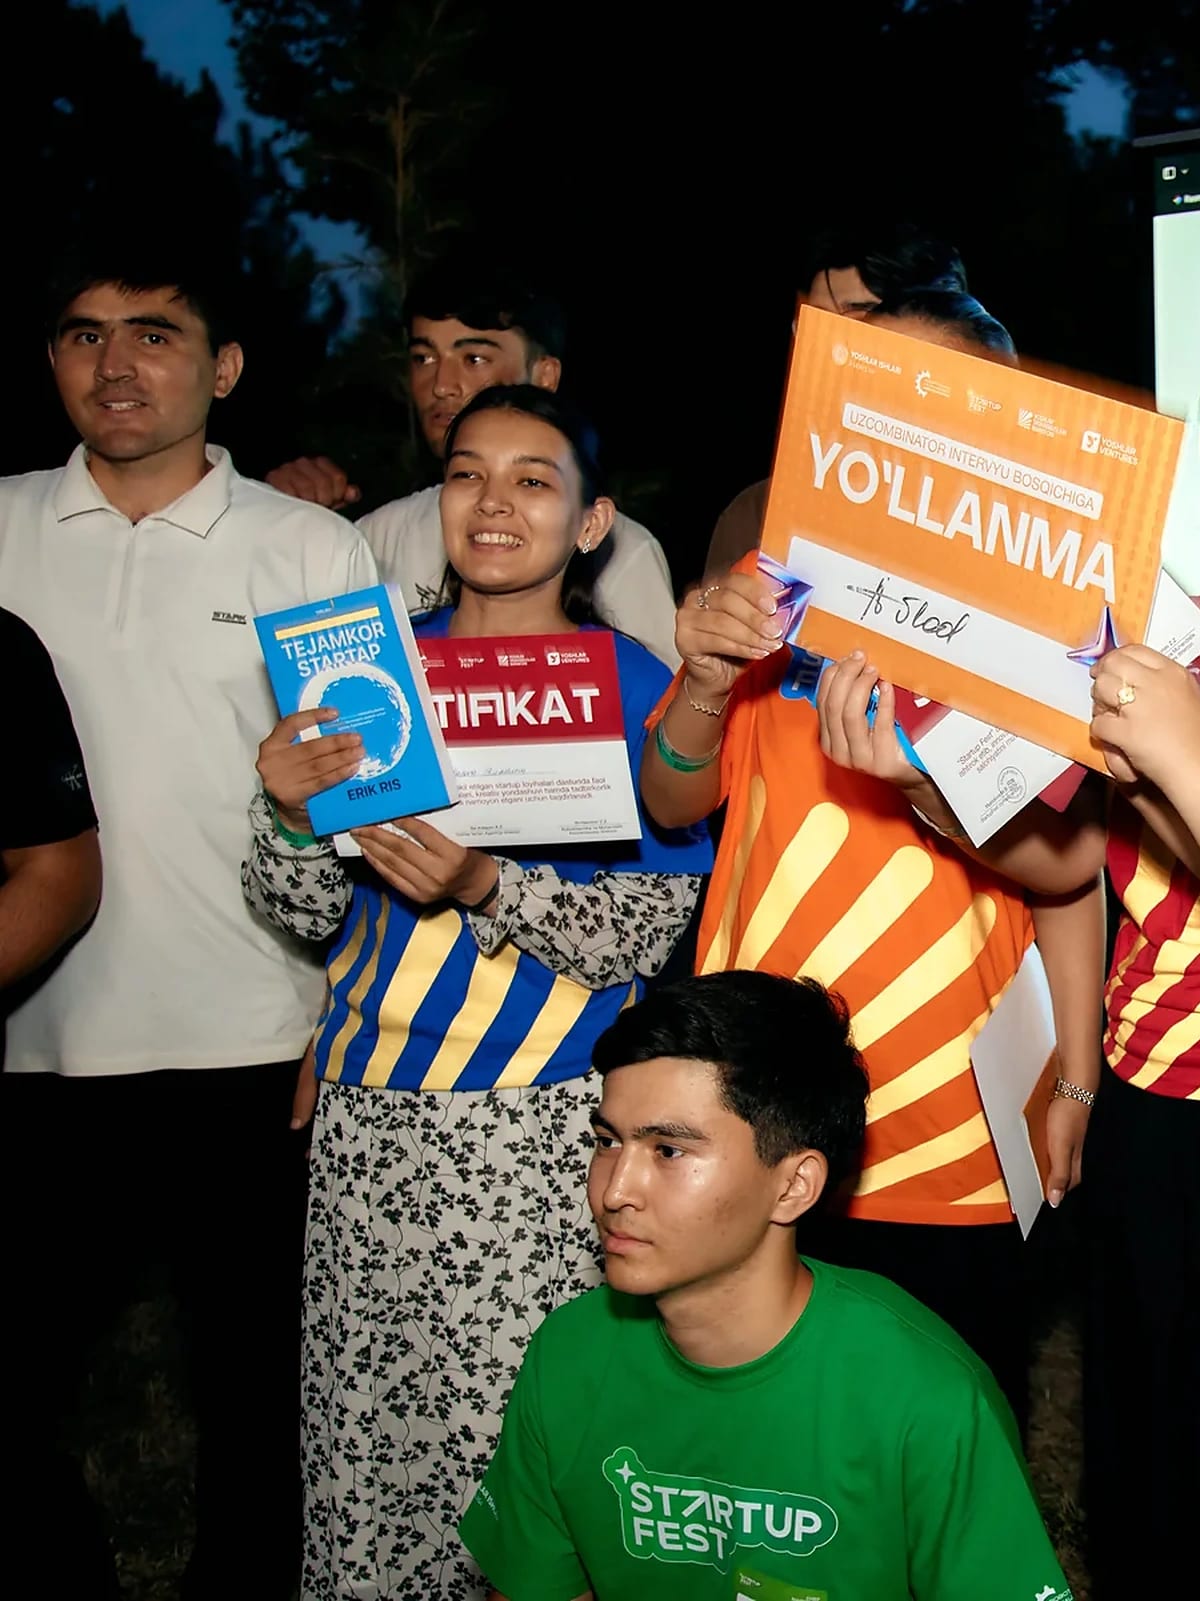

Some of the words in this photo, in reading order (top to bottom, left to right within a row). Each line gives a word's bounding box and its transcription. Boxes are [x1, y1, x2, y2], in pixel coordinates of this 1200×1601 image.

[850, 410, 946, 458] UZCOMBINATOR
[948, 447, 1011, 480] INTERVYU
[1012, 469, 1095, 511] BOSQICHIGA
[1100, 446, 1138, 465] VENTURES
[1101, 437, 1137, 456] YOSHLAR
[810, 432, 1115, 604] YO'LLANMA
[281, 620, 387, 660] TEJAMKOR
[297, 643, 381, 678] STARTAP
[346, 784, 378, 801] ERIK
[379, 778, 402, 794] RIS
[630, 1481, 823, 1542] STARTUP
[633, 1516, 728, 1560] FEST
